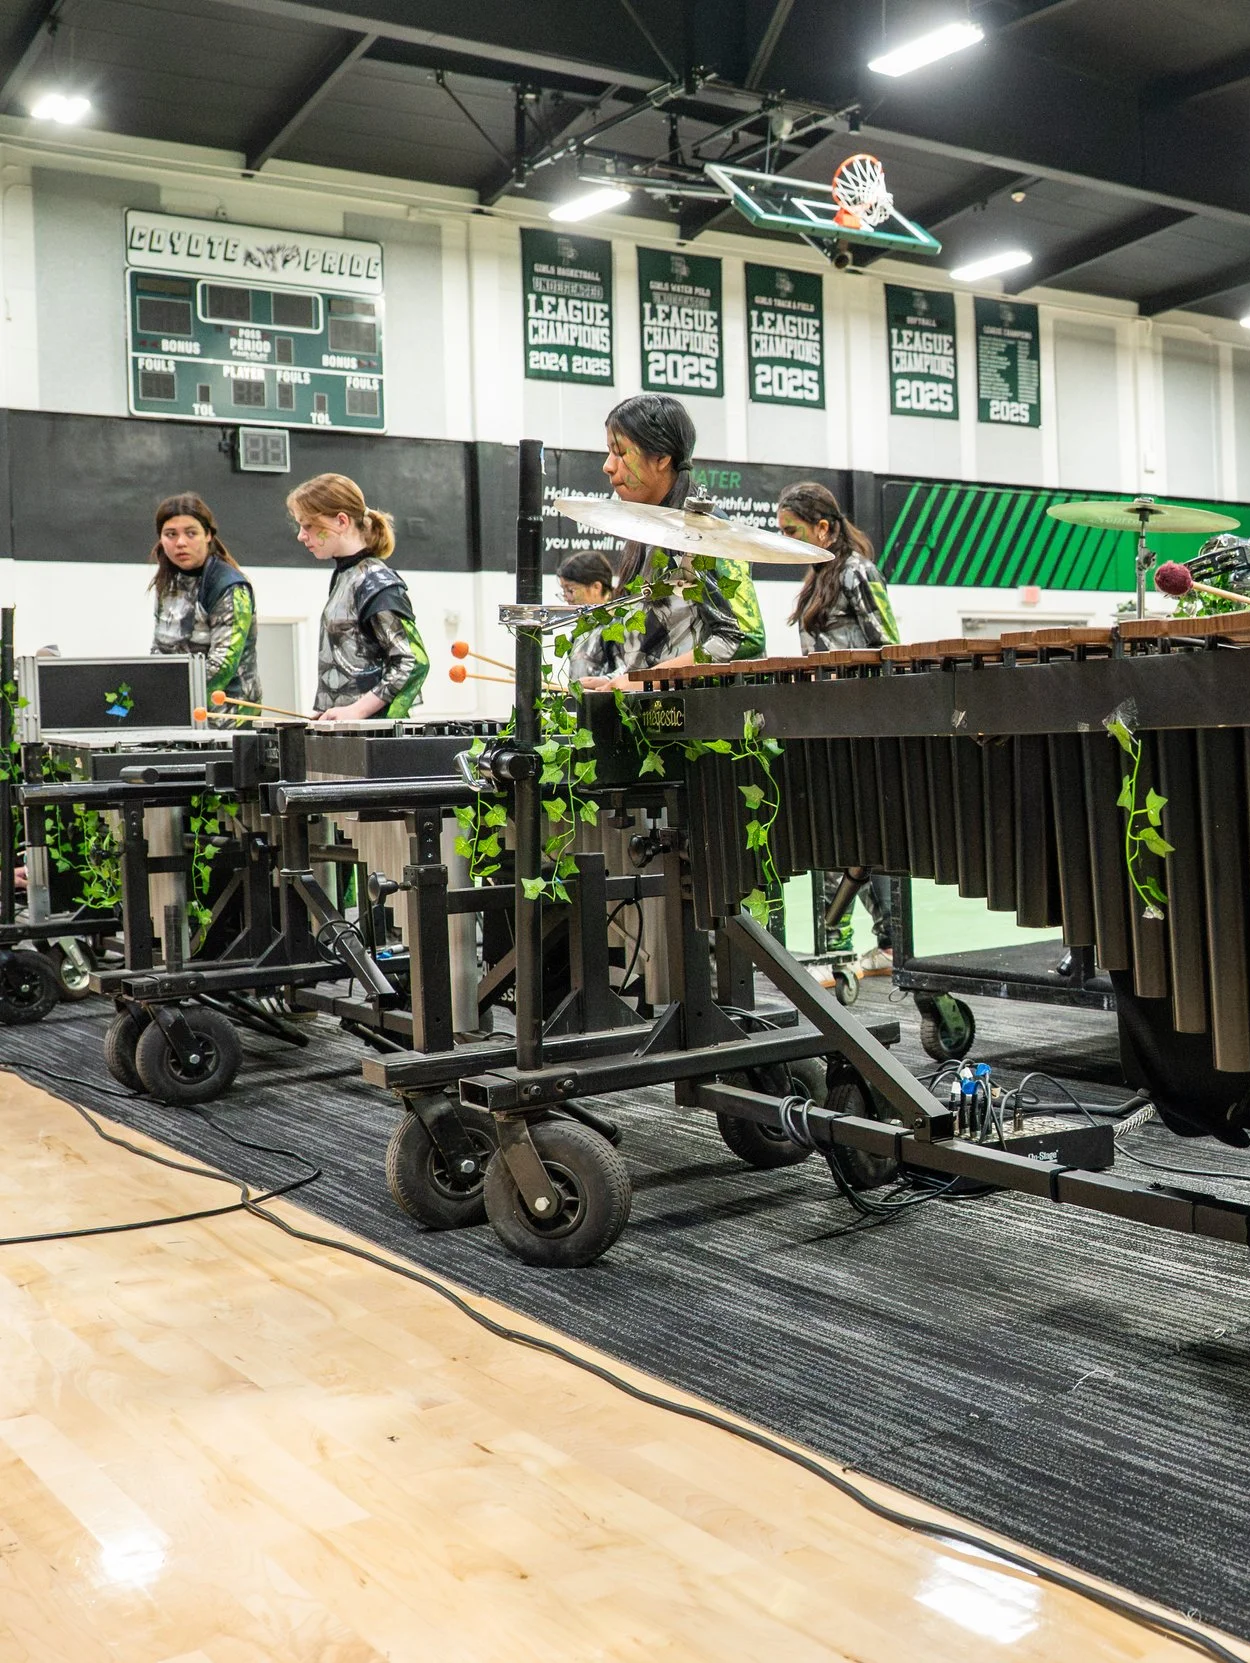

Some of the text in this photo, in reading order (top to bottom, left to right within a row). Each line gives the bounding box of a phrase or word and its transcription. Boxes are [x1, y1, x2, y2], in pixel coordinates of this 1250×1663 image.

[129, 226, 380, 279] COYOTE PRIDE
[528, 293, 610, 326] LEAGUE
[643, 302, 718, 333] LEAGUE
[528, 319, 610, 353] CHAMPIONS
[751, 310, 820, 342] LEAGUE
[161, 339, 200, 354] BONUS
[230, 337, 271, 353] PERIOD
[643, 325, 719, 359] CHAMPIONS
[751, 333, 821, 366] CHAMPIONS
[891, 328, 954, 356] LEAGUE
[138, 358, 175, 372] FOULS
[223, 365, 265, 380] PLAYER
[322, 355, 358, 370] BONUS
[529, 350, 611, 377] 2024 2025
[648, 351, 718, 389] 2025
[892, 350, 955, 380] CHAMPIONS
[276, 370, 310, 385] FOULS
[346, 376, 379, 390] FOULS
[755, 363, 820, 401] 2025
[895, 378, 954, 413] 2025
[193, 403, 216, 417] TOL
[310, 412, 332, 425] TOL
[989, 400, 1030, 423] 2025
[691, 468, 741, 489] ATER
[753, 501, 770, 512] we
[545, 538, 569, 551] you
[571, 538, 590, 550] we
[592, 535, 614, 551] will
[642, 706, 683, 732] majestic
